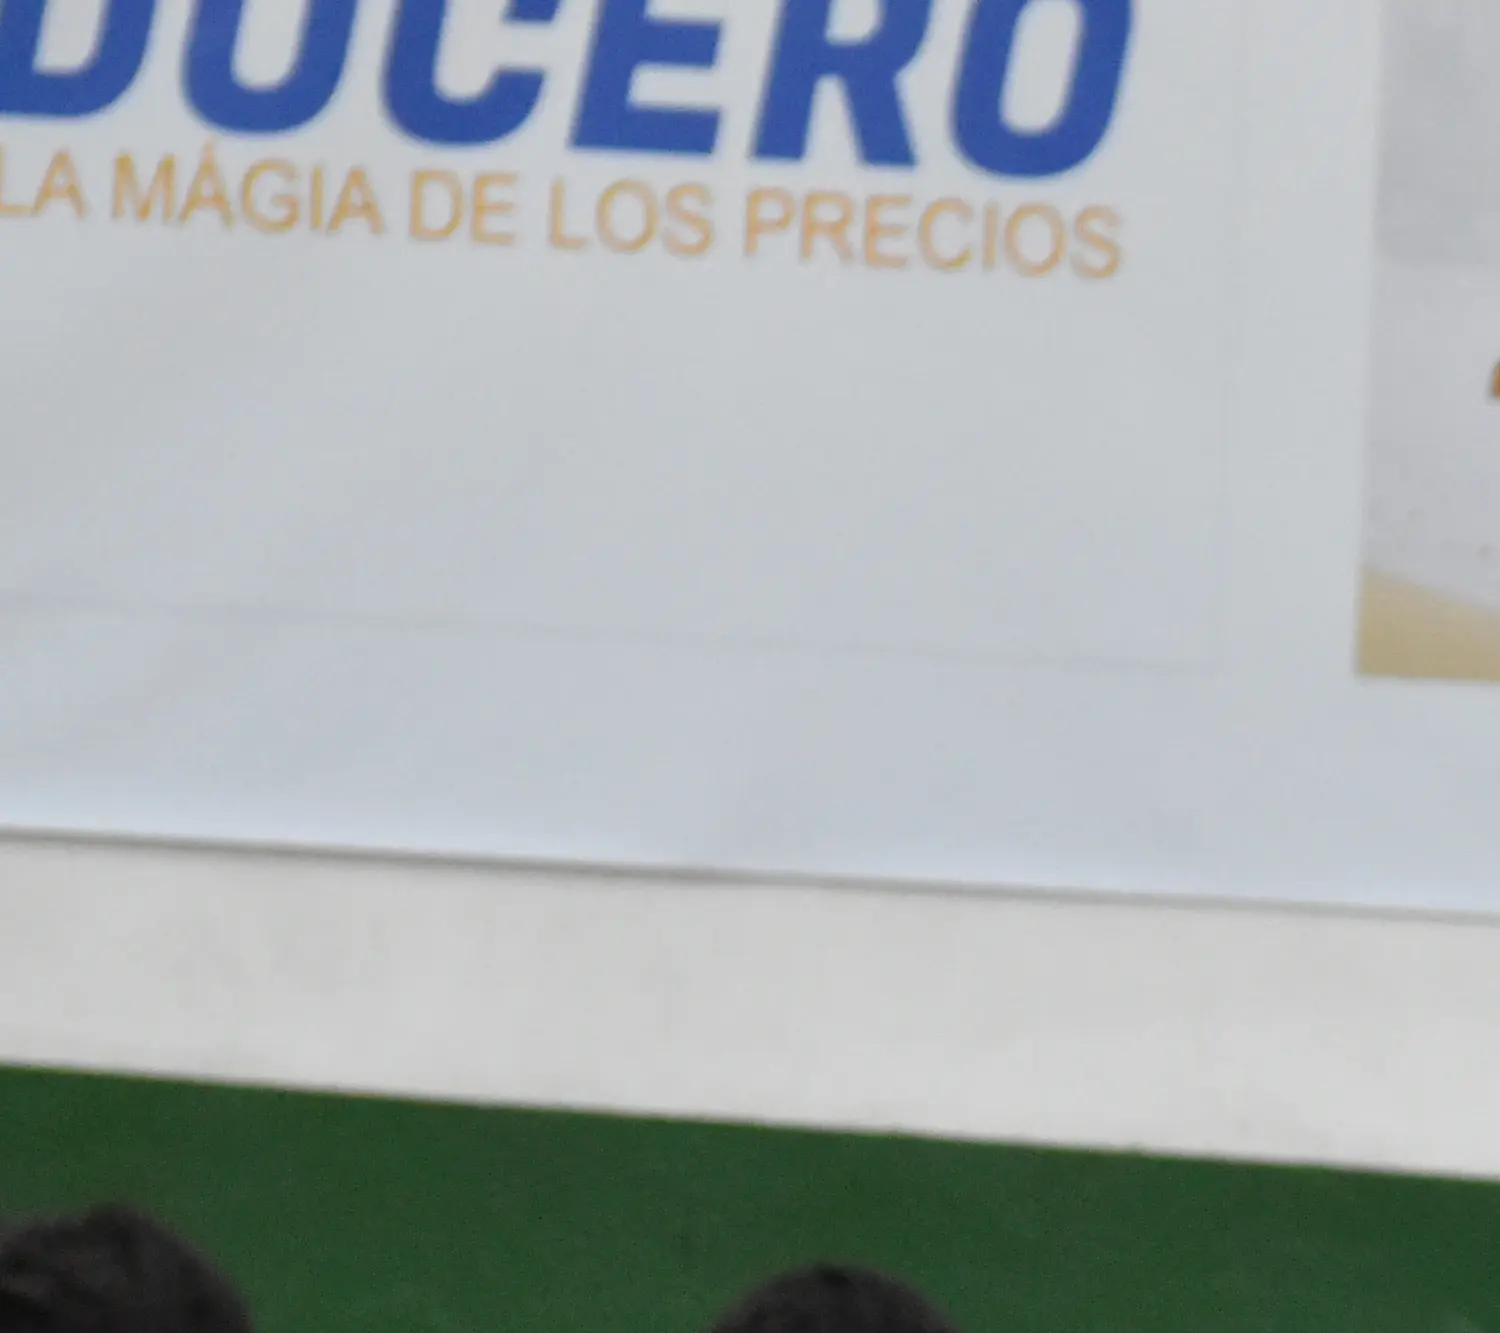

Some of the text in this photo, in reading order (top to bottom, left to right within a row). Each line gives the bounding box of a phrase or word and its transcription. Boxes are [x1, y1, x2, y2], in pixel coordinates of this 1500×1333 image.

[0, 143, 86, 221] LA
[408, 170, 517, 247] DE
[549, 178, 714, 260] LOS
[743, 190, 1124, 282] PRECIOS
